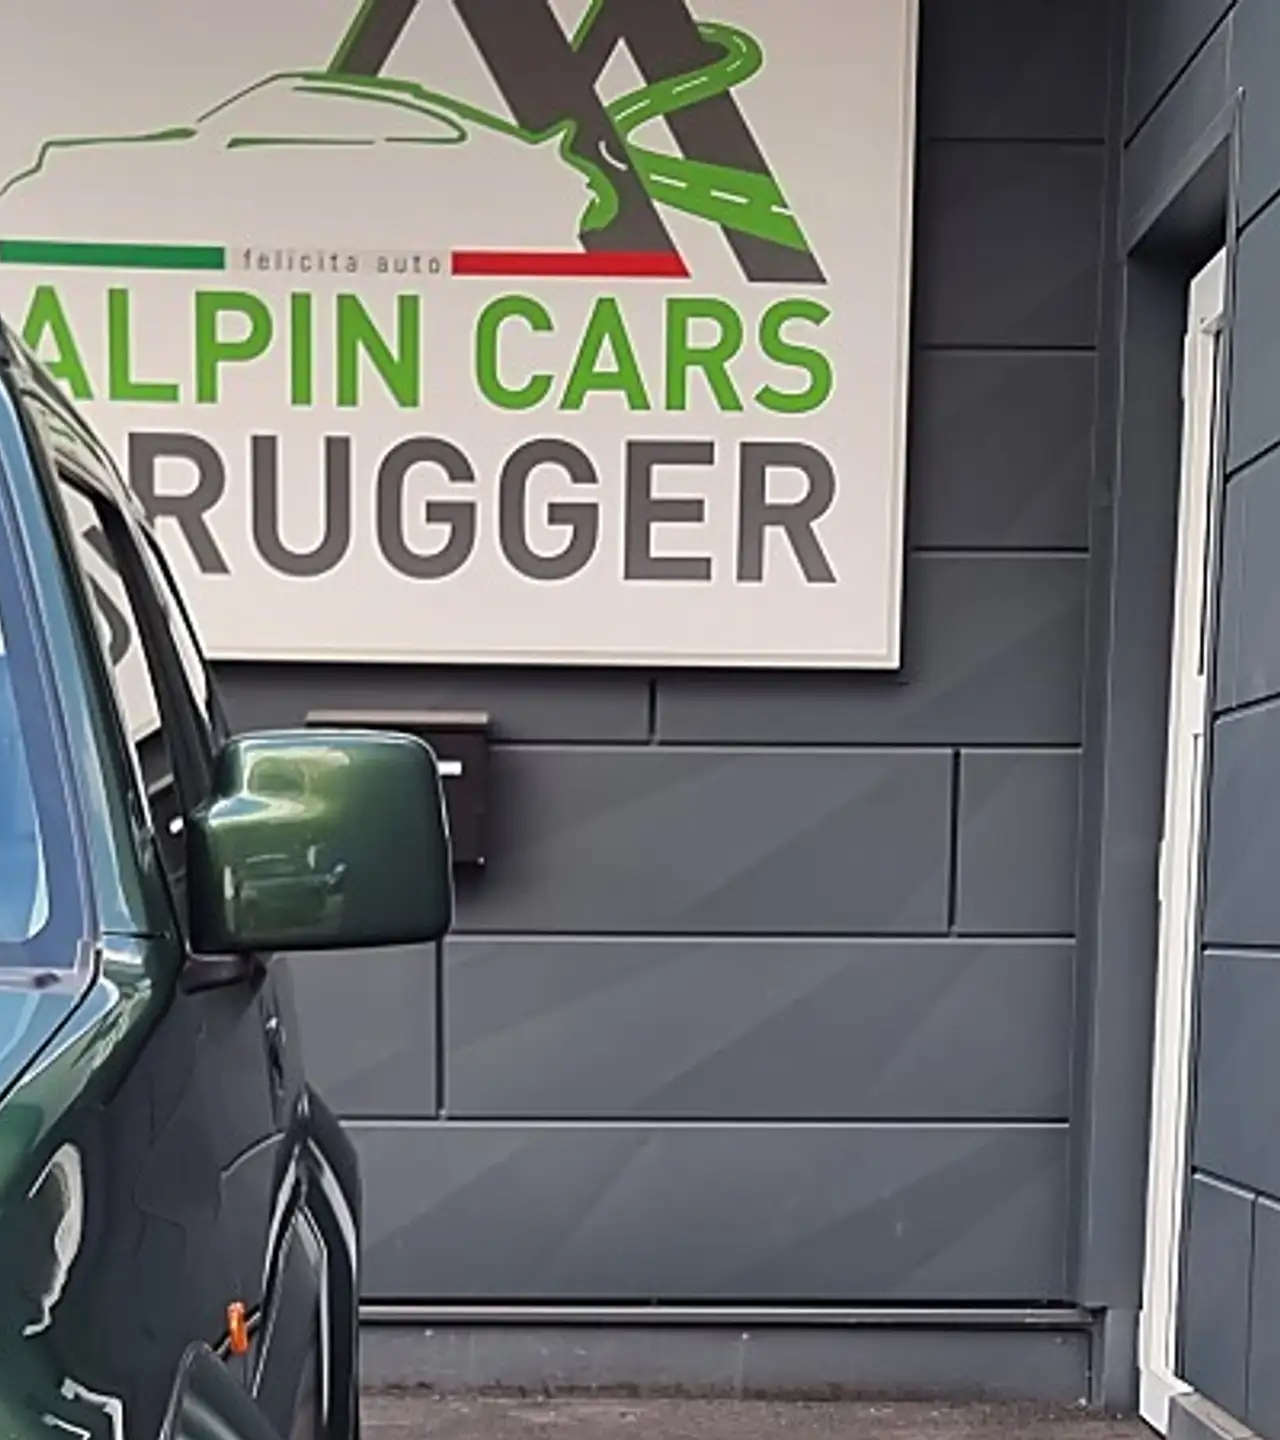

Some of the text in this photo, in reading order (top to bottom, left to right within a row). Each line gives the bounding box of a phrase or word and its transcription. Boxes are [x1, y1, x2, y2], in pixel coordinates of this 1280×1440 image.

[242, 247, 442, 275] felicita auto
[21, 284, 836, 415] ALPIN CARS
[126, 430, 838, 585] RUGGER
